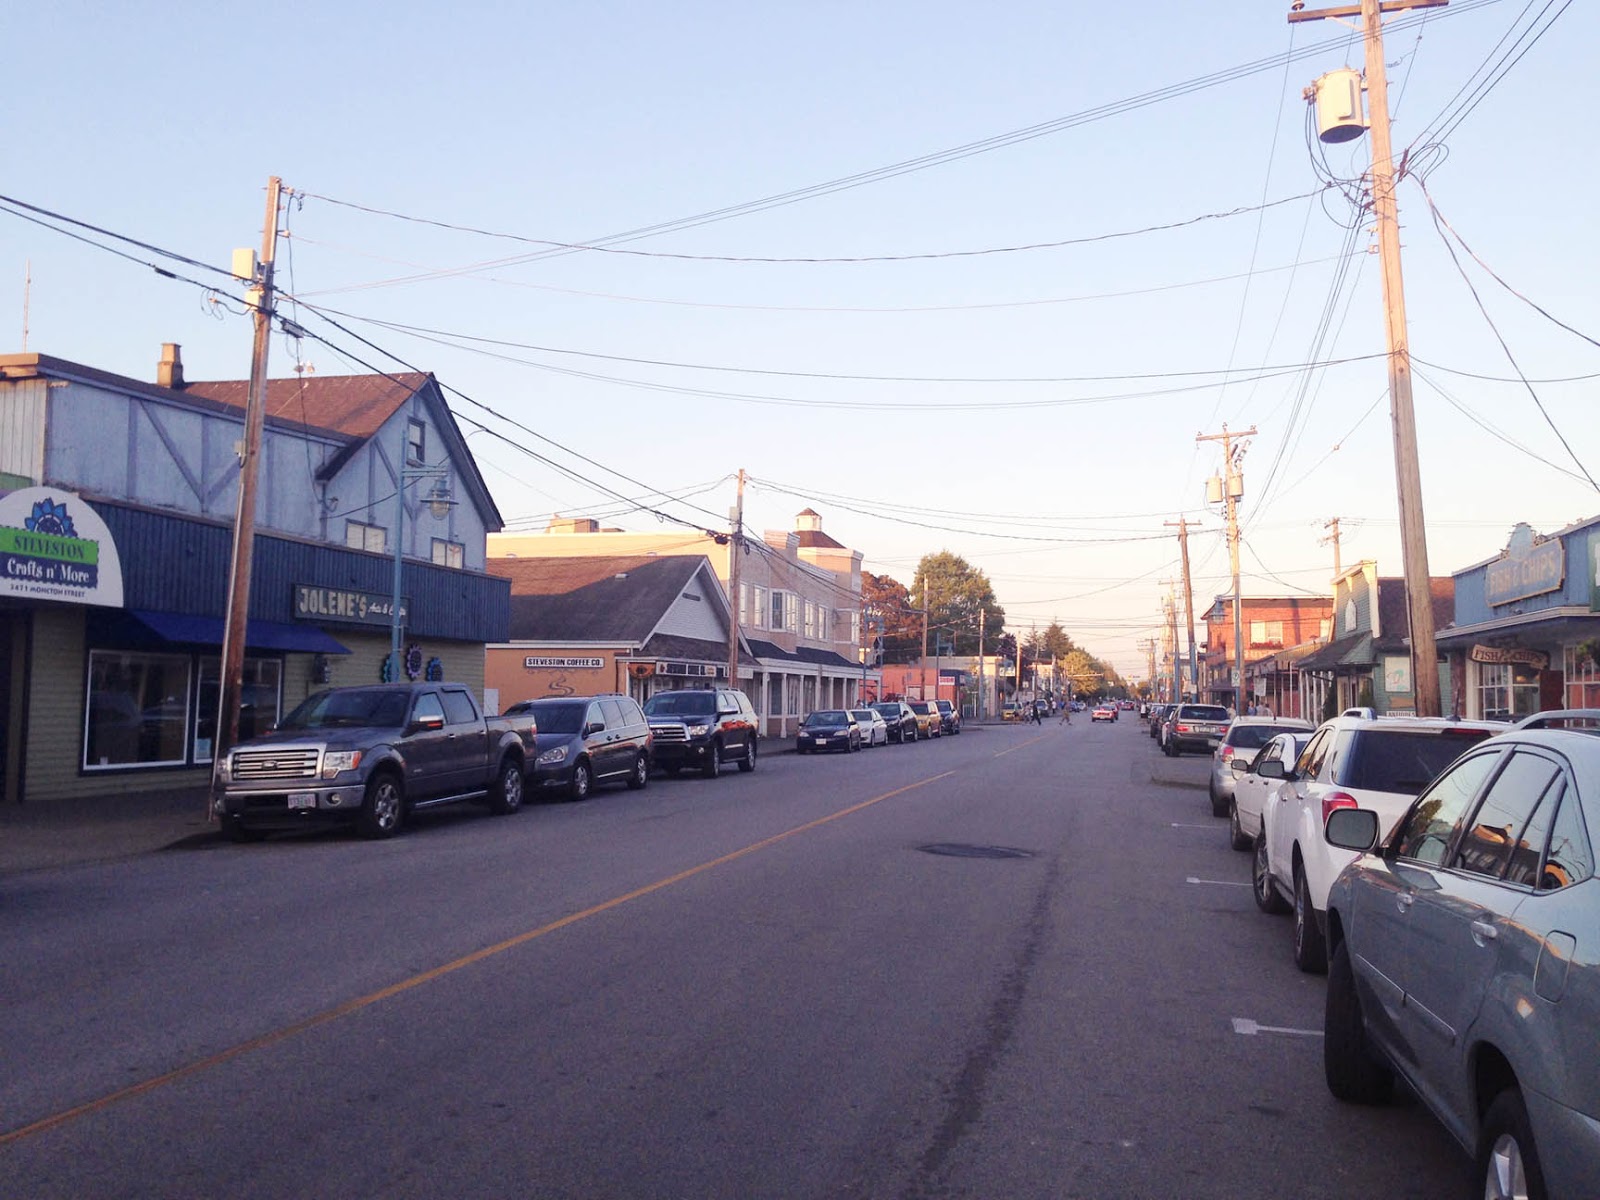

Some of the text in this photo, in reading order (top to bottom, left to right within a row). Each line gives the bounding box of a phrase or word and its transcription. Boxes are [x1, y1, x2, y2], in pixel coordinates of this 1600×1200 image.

[14, 535, 85, 559] STEVESTON
[7, 557, 43, 578] Crafts
[60, 564, 90, 583] More
[64, 589, 86, 598] STREET
[299, 588, 368, 618] JOLENE'S
[527, 658, 565, 666] STEVESTON
[566, 658, 589, 666] COFFEE
[1474, 649, 1499, 661] FISH
